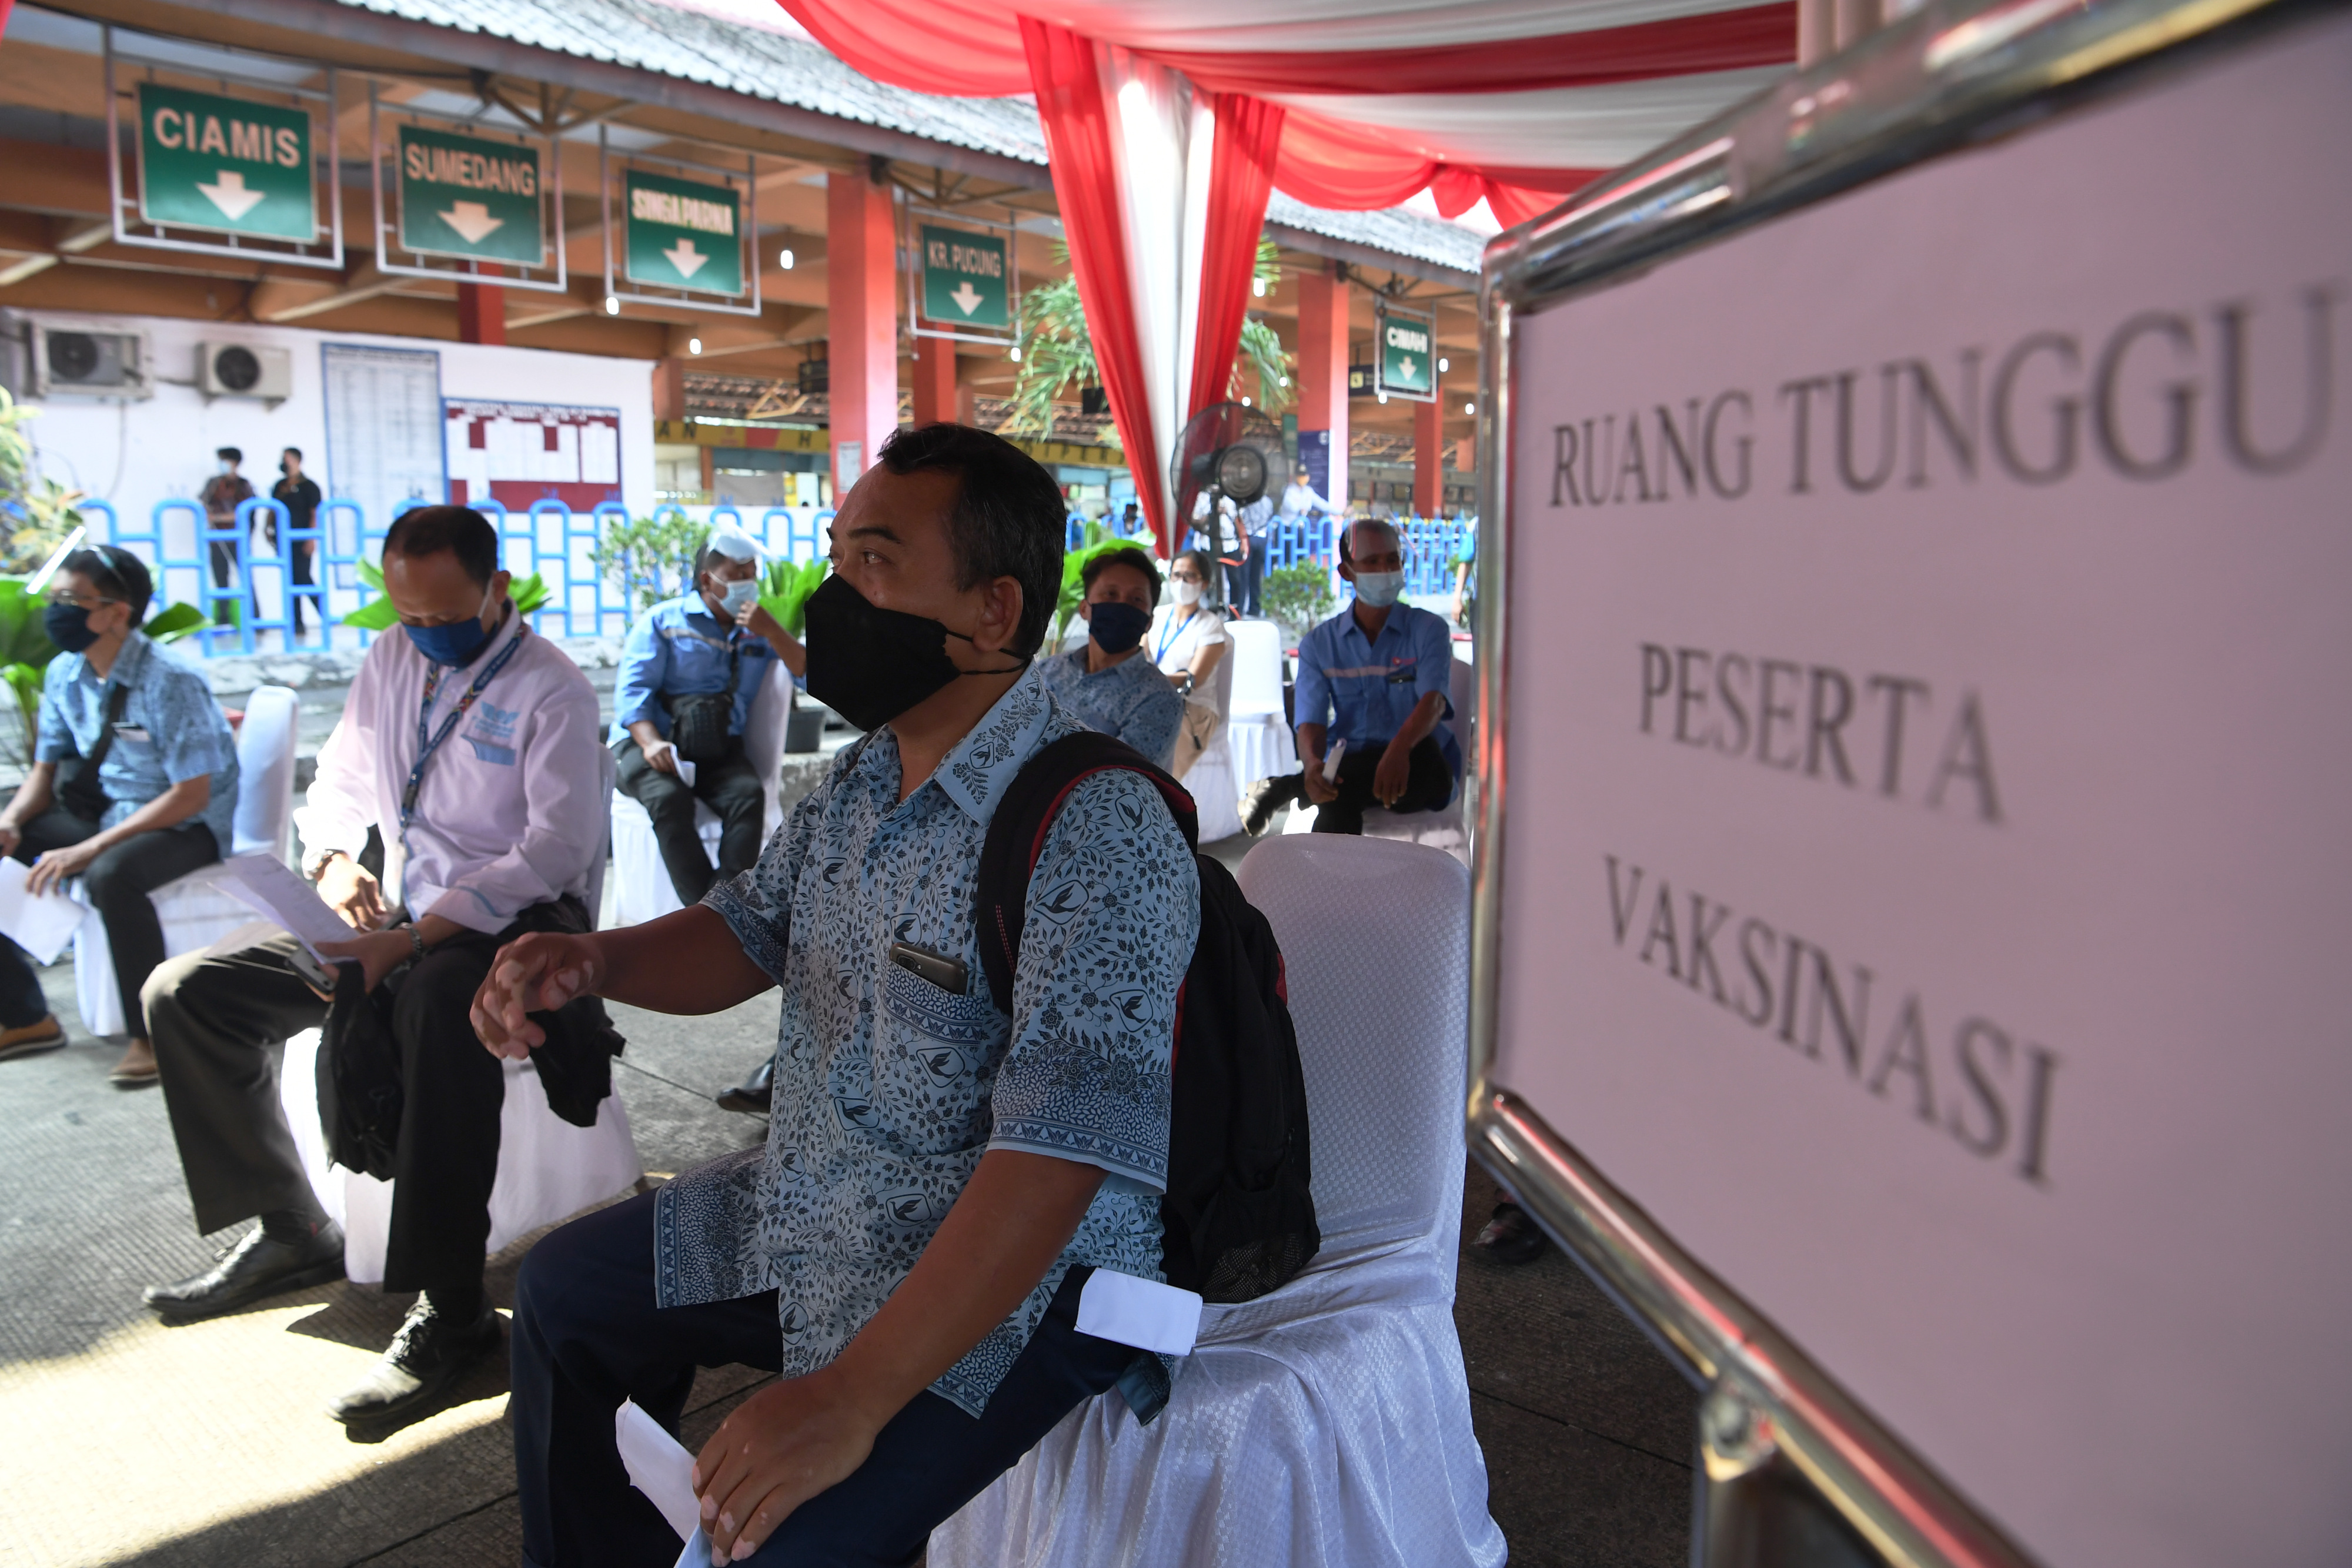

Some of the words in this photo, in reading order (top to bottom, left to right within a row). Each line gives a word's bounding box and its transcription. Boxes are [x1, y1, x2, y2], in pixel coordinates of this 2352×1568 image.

[152, 107, 301, 168] CIAMIS
[406, 143, 536, 196] SUMEDANG
[1548, 388, 1757, 508] RUANG
[1779, 286, 2338, 493] TUNGGU
[1638, 641, 2007, 828] PESERTA
[1603, 852, 2065, 1191] VAKSINASI
